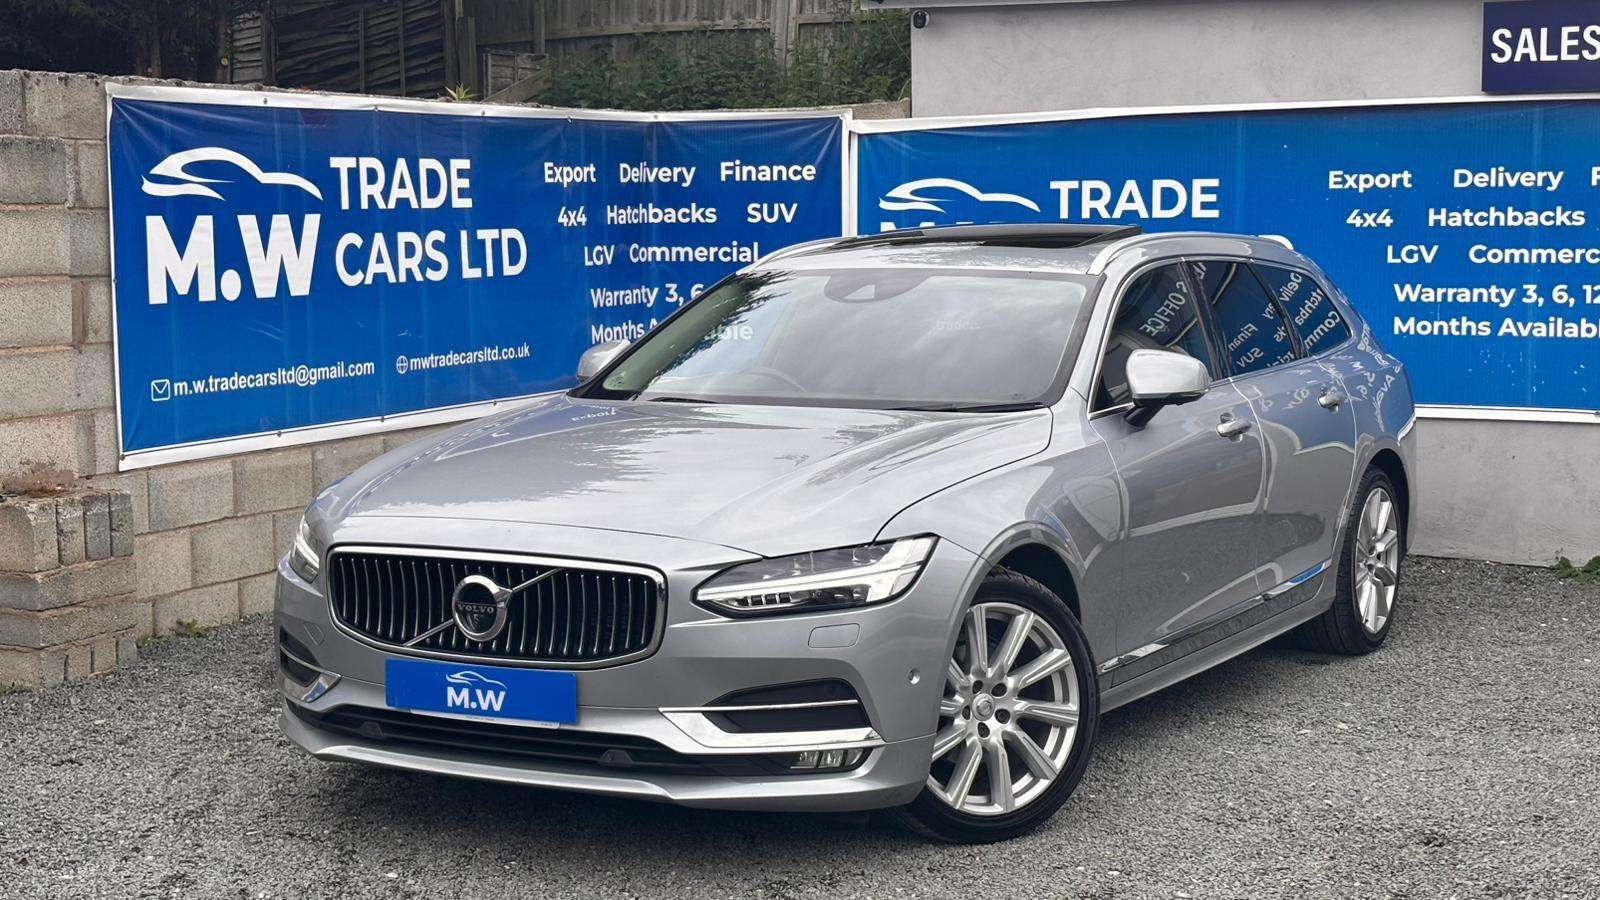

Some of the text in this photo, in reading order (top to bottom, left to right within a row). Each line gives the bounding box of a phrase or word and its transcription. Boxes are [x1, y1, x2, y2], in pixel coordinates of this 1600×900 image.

[1490, 24, 1600, 64] SALES
[329, 156, 473, 210] TRADE
[544, 159, 817, 188] Export Delivery Finance
[1328, 170, 1413, 193] Export
[1453, 166, 1564, 192] Delivery
[1049, 178, 1220, 219] TRADE
[557, 202, 798, 227] 4x4 Hatchbacks SUV
[1346, 205, 1586, 228] 4x4 Hatchbacks
[145, 213, 321, 305] M.W
[335, 228, 528, 287] CARS LTD
[584, 240, 758, 267] LGV Commercial
[1387, 244, 1600, 264] LGV Commerc
[590, 285, 659, 308] Warranty
[665, 283, 684, 307] 3,
[1393, 283, 1516, 308] Warranty
[1522, 284, 1545, 307] 3,
[1552, 284, 1575, 308] 6,
[591, 320, 645, 344] Months
[1393, 316, 1600, 338] Months Availab
[409, 344, 530, 371] mwtradecarsltd.co.uk
[173, 361, 375, 396] m.w.tradecarsltd@gmail.com
[457, 603, 494, 614] VOLVO
[446, 686, 505, 712] M.W
